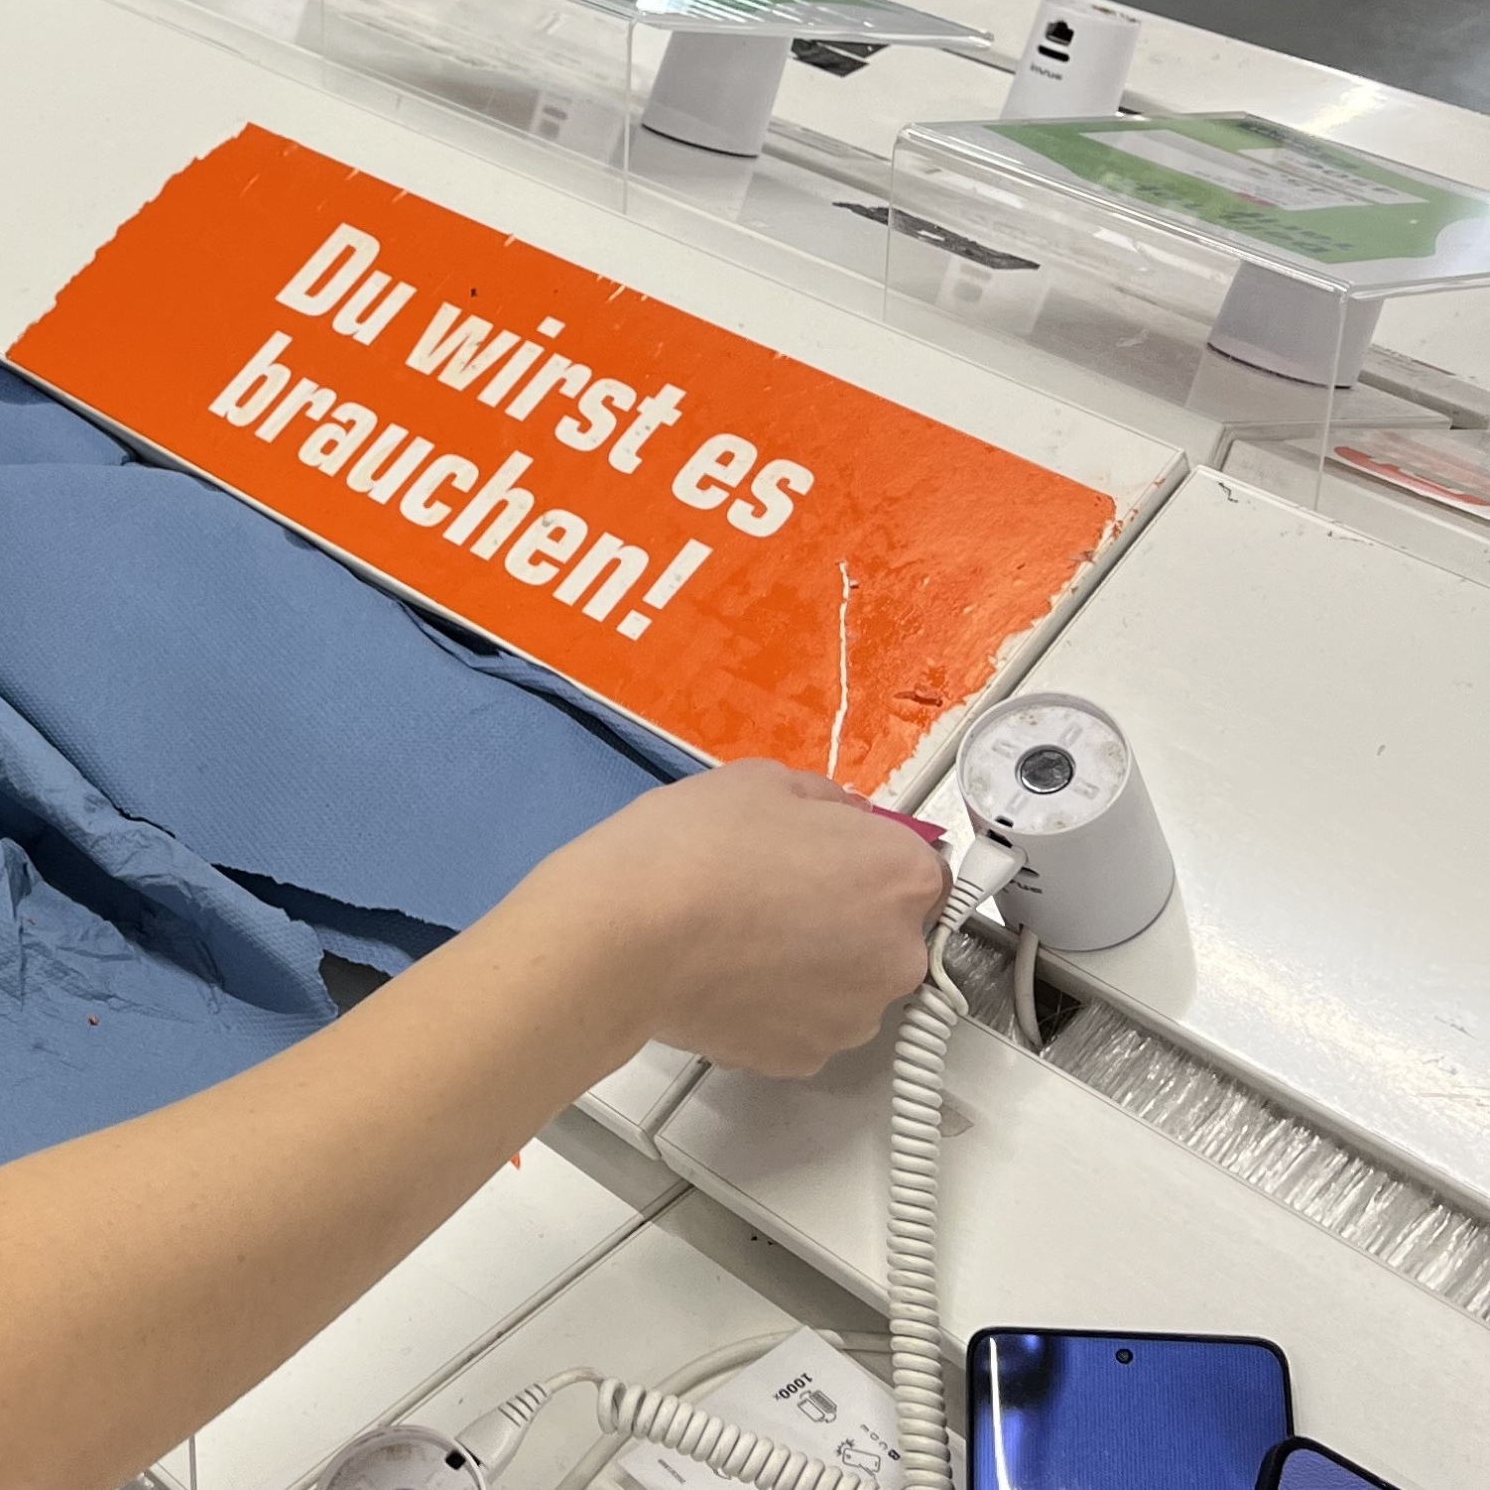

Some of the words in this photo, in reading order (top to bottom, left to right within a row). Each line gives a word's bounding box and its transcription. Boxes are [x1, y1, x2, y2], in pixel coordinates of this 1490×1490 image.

[208, 331, 712, 641] brauchen!
[276, 223, 416, 346] Du
[405, 302, 686, 474] wirst
[671, 433, 815, 538] es
